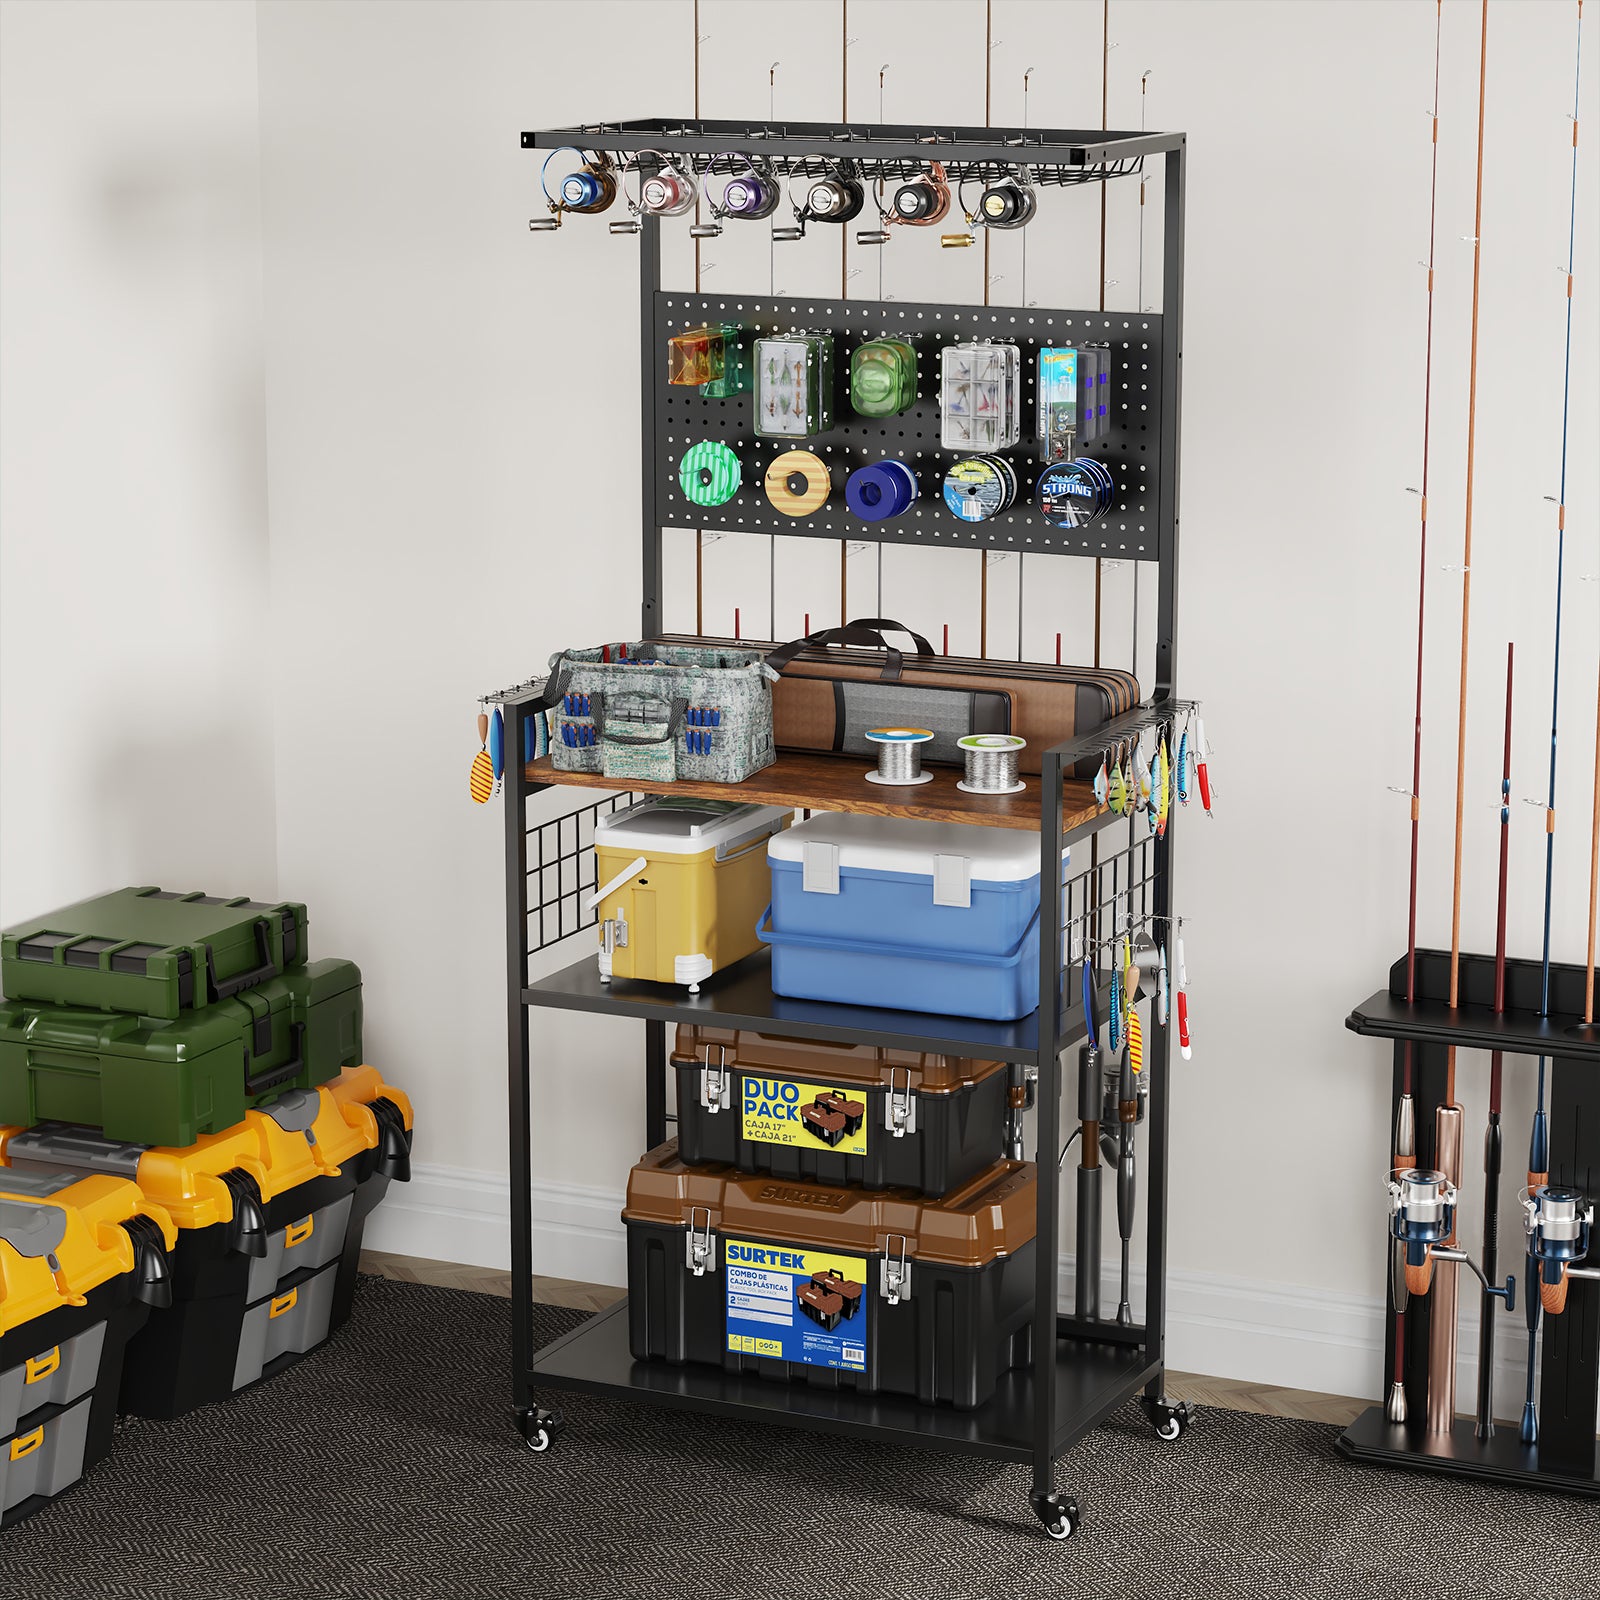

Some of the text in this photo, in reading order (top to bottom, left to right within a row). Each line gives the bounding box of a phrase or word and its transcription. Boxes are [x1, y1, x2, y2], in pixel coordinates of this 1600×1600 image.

[1042, 483, 1092, 497] STRONG
[744, 1078, 799, 1103] DUO
[744, 1099, 799, 1122] PACK
[745, 1119, 771, 1130] CAJA
[728, 1245, 805, 1269] SURTEK
[730, 1269, 757, 1279] COMBO
[730, 1278, 788, 1292] CAJAS PLÁSTICAS
[730, 1296, 736, 1304] 2
